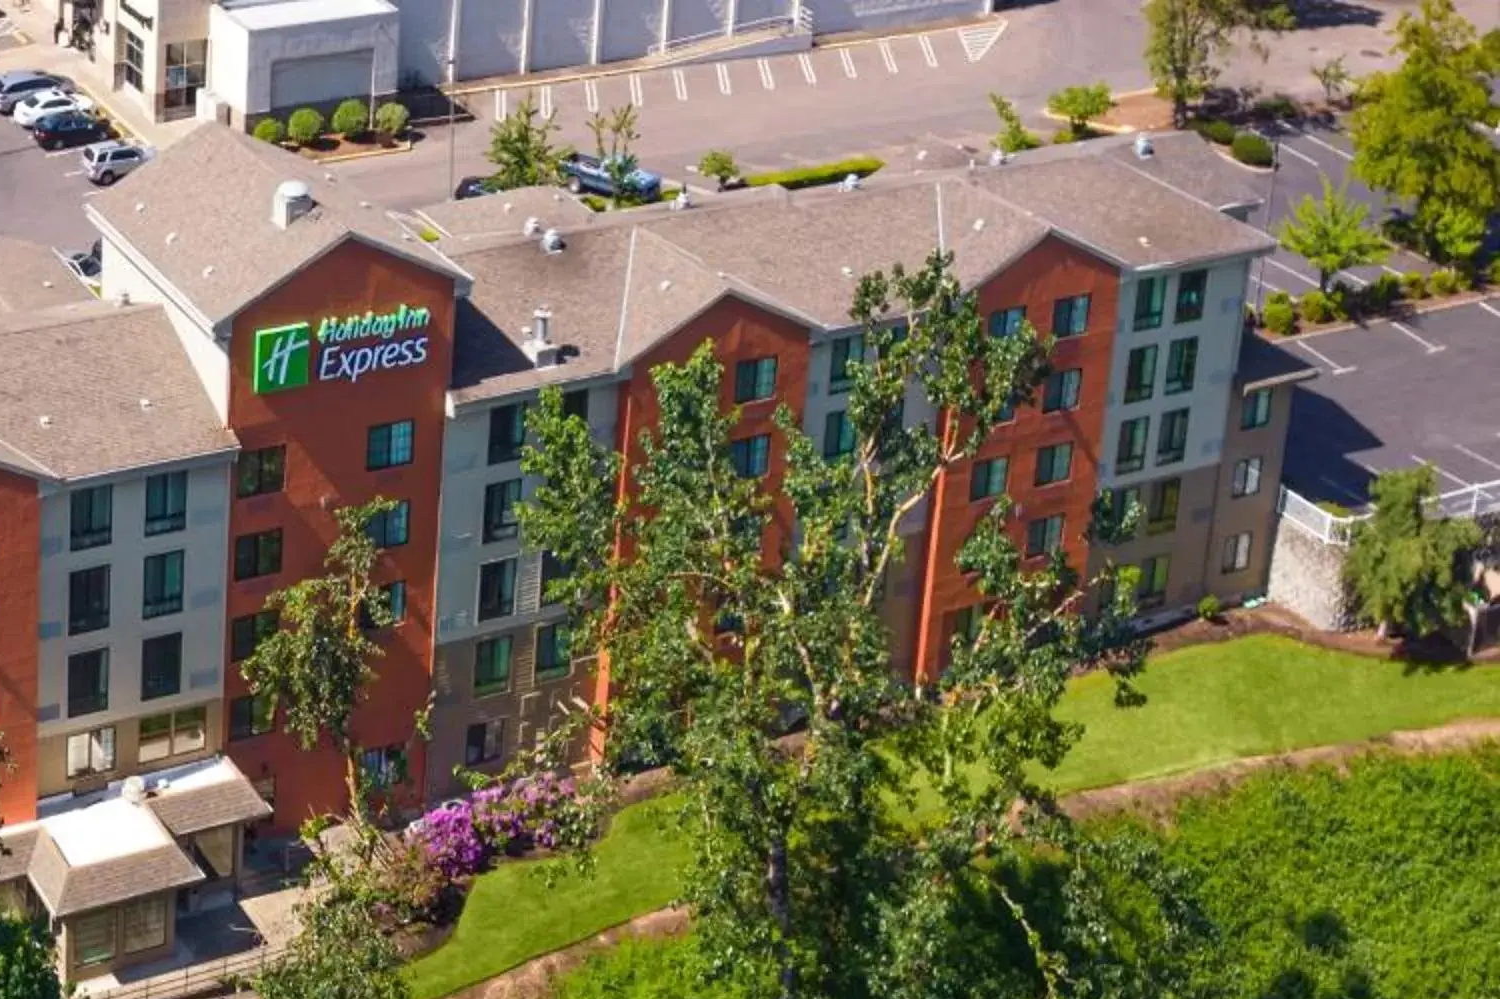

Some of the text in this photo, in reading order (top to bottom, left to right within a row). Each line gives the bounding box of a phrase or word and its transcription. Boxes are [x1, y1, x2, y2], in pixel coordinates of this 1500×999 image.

[317, 303, 431, 344] Holiday Inn
[318, 336, 429, 383] Express
